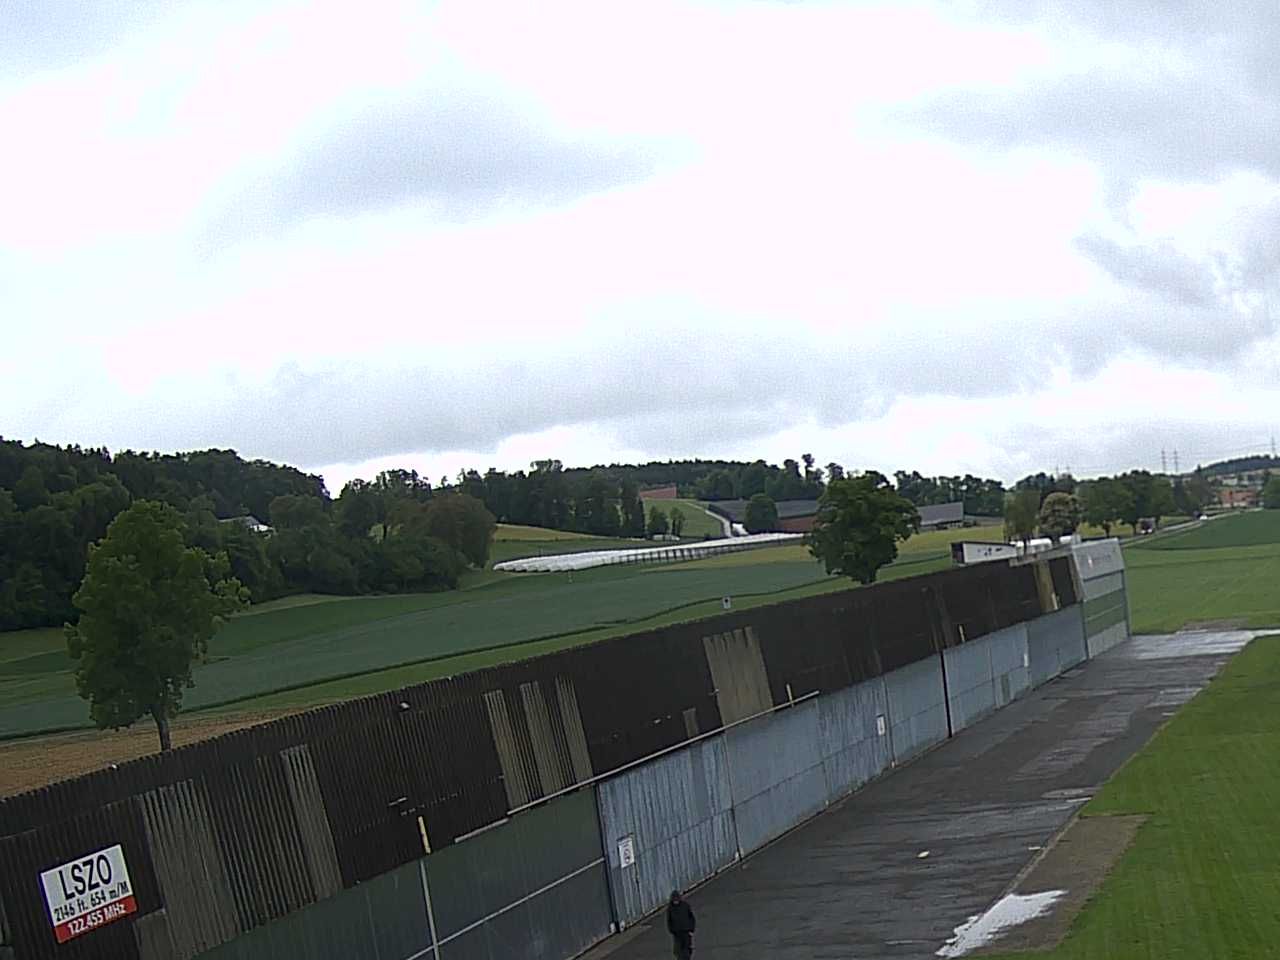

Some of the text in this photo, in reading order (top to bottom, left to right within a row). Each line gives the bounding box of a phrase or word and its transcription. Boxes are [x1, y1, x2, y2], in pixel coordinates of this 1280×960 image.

[58, 854, 112, 900] LSZO
[67, 903, 126, 935] 122.455 MHz
